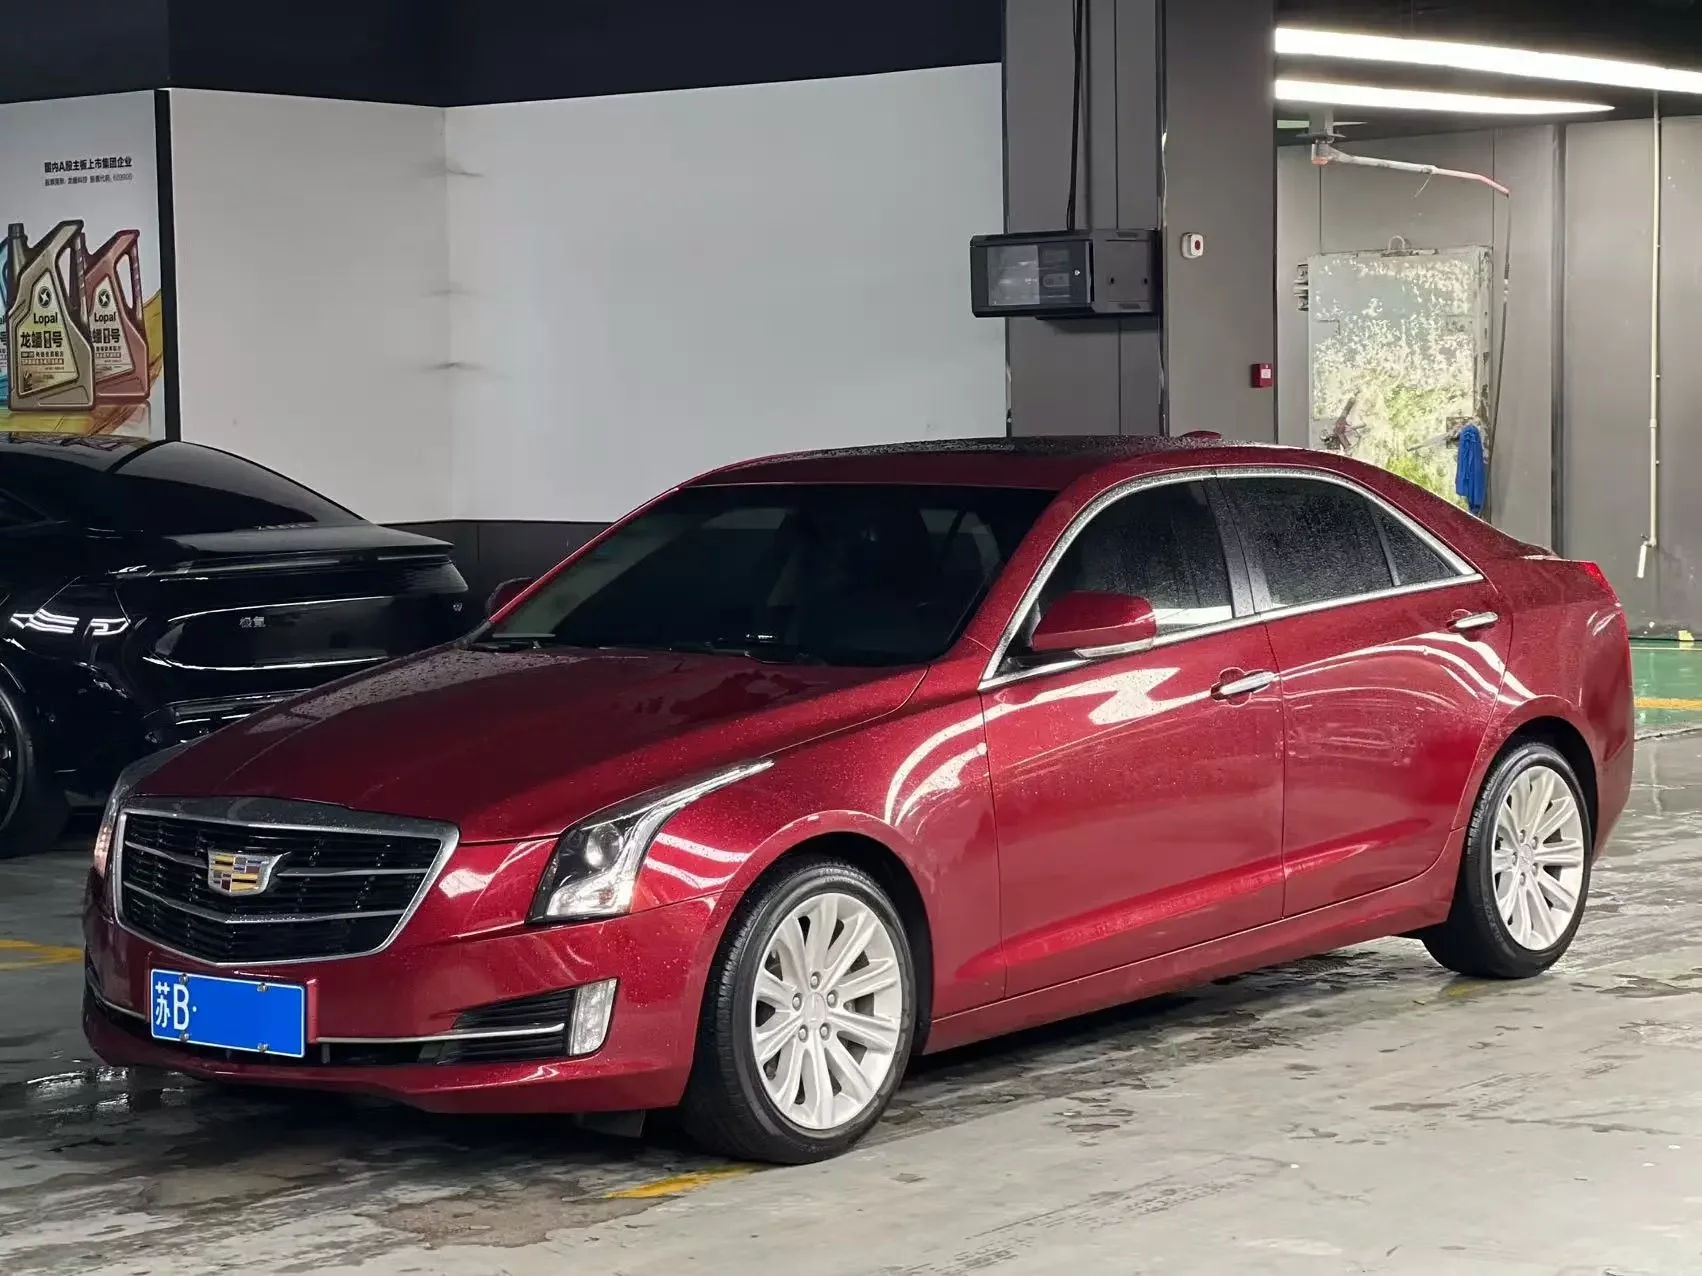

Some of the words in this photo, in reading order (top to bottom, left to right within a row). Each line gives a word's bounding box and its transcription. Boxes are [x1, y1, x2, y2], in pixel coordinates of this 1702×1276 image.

[44, 156, 132, 173] 国内A股主板上市集团企业
[33, 312, 58, 326] Lopal
[94, 311, 116, 324] Lopal
